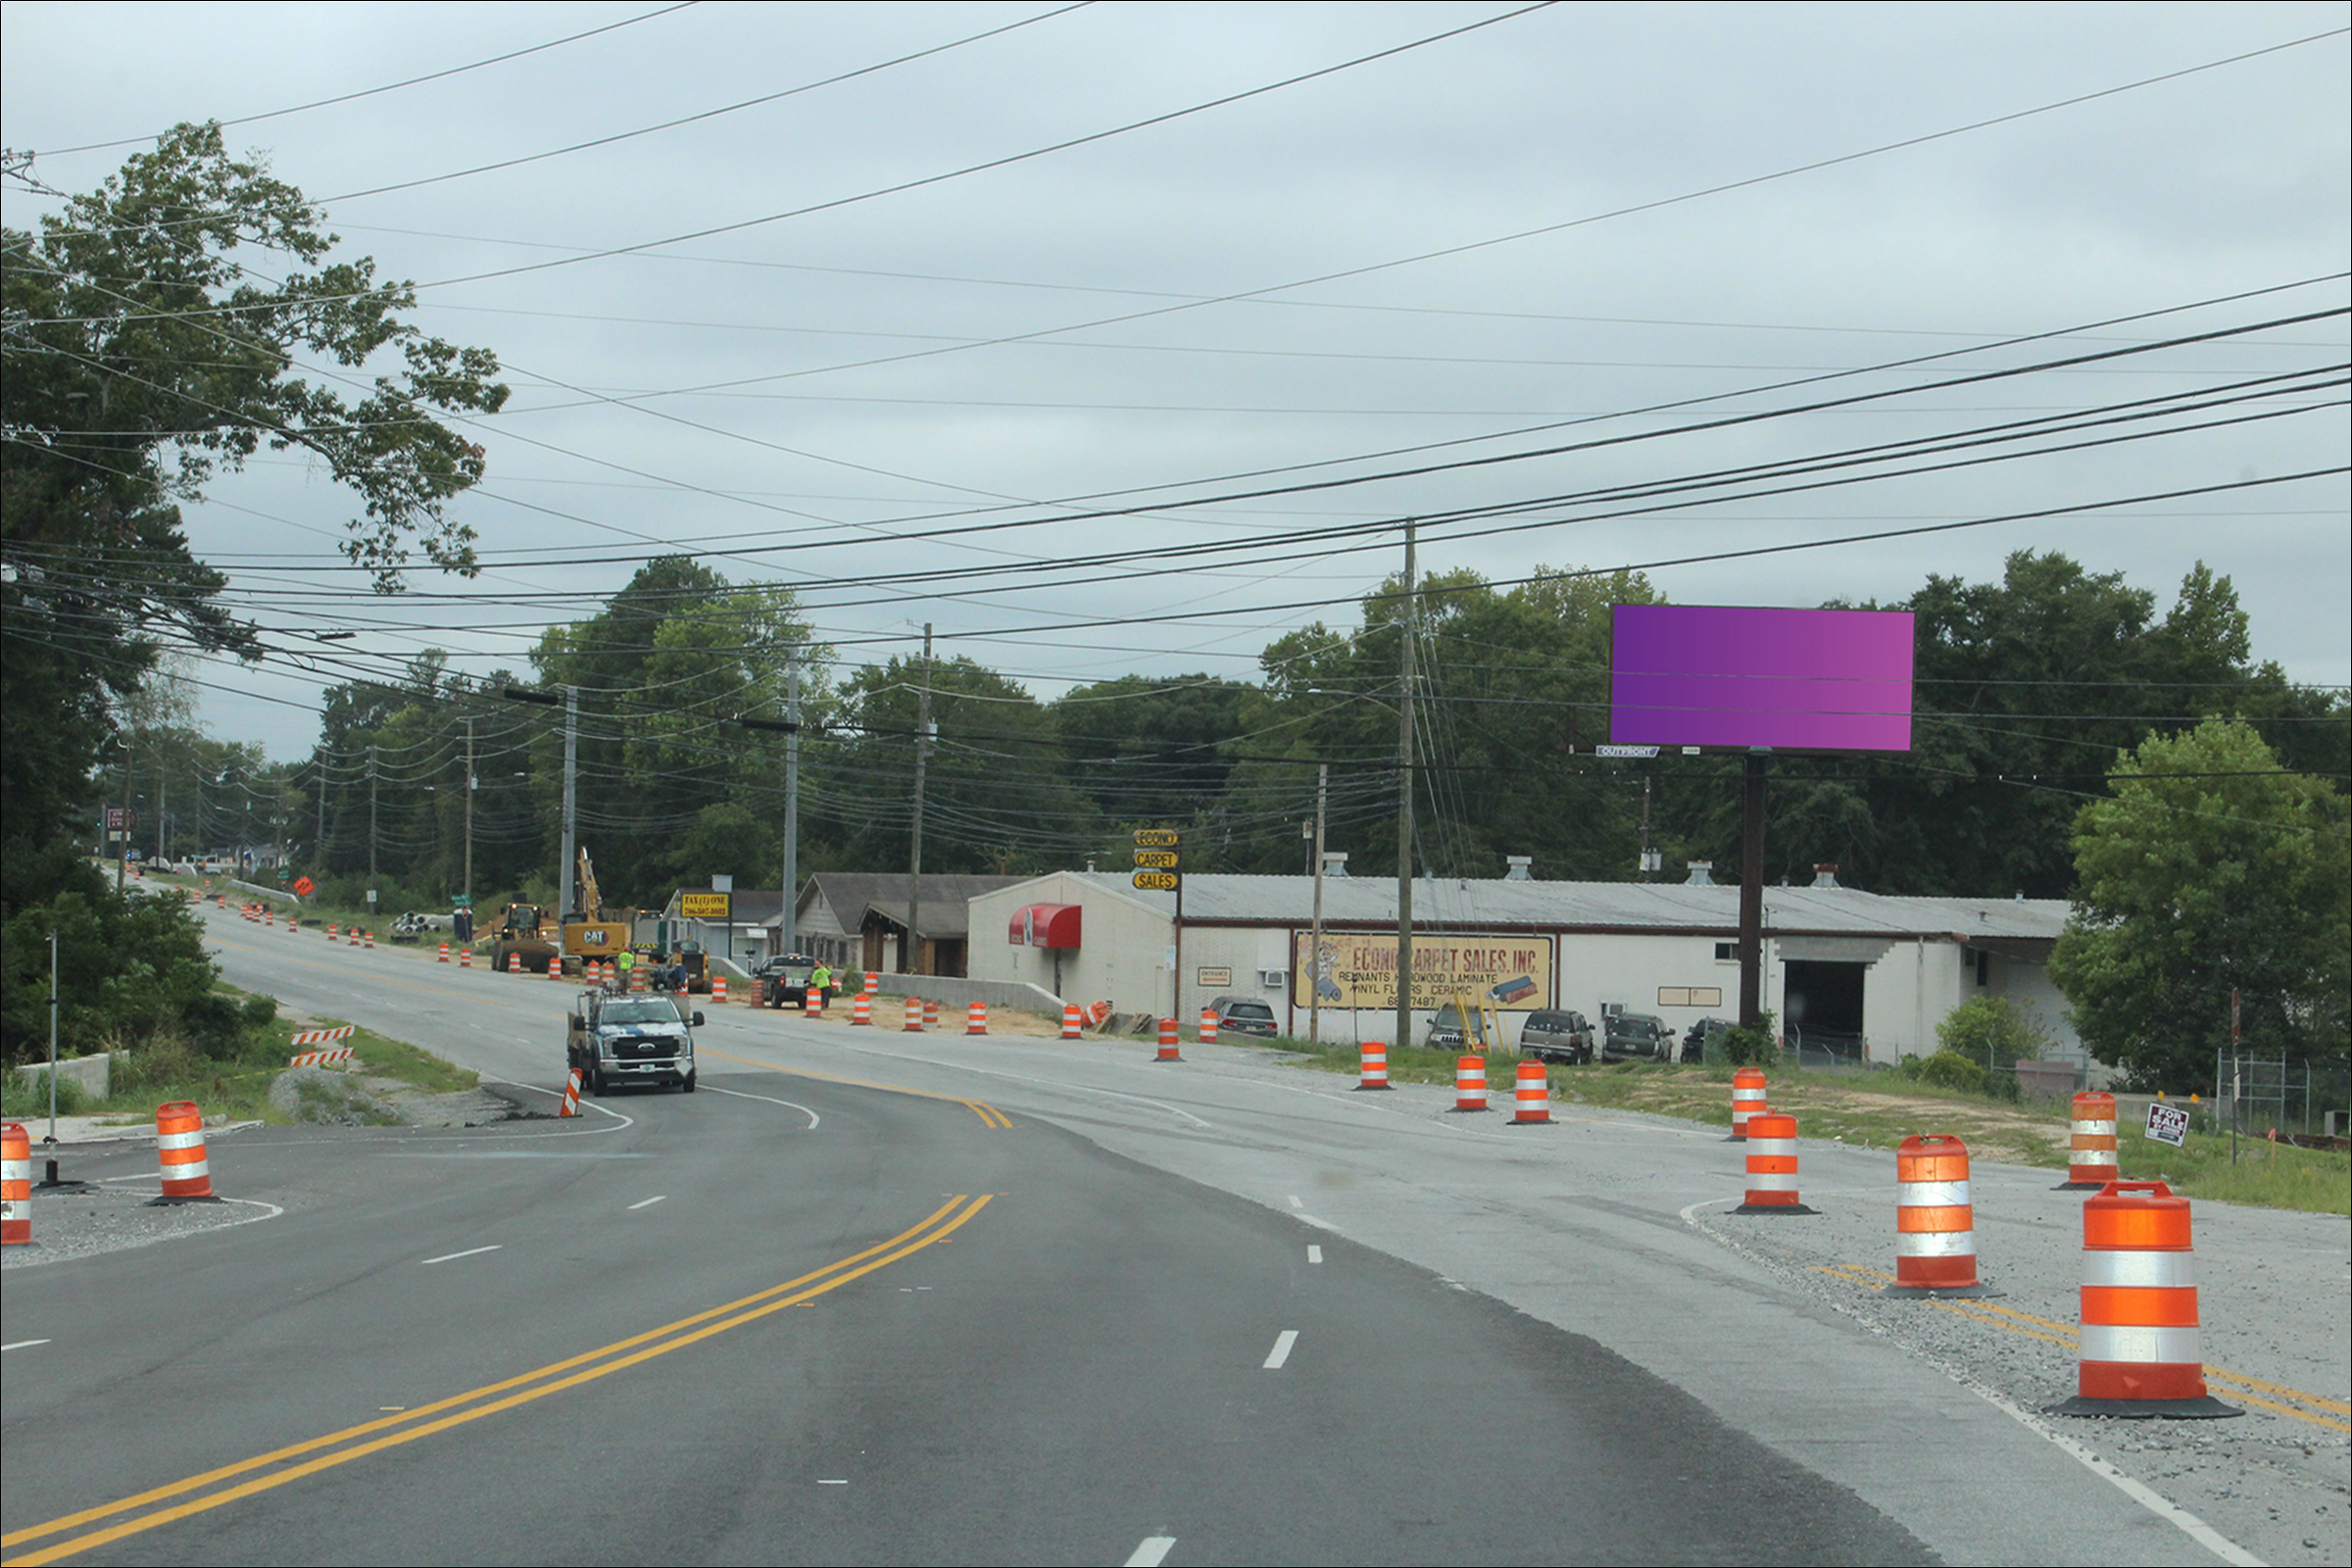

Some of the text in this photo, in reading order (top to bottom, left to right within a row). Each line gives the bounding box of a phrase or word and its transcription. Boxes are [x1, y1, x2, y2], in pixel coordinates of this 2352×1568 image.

[1602, 746, 1650, 757] OUTFRONT
[1137, 854, 1173, 866] CARPET
[1139, 874, 1172, 888] SALES
[710, 896, 726, 905] ONE
[584, 931, 604, 944] CAT
[1339, 971, 1390, 982] REMNANTS
[1450, 974, 1497, 984] LAMINATE
[1431, 984, 1472, 995] CERAMIC
[2158, 1108, 2181, 1120] FOR
[2152, 1114, 2184, 1129] SALE
